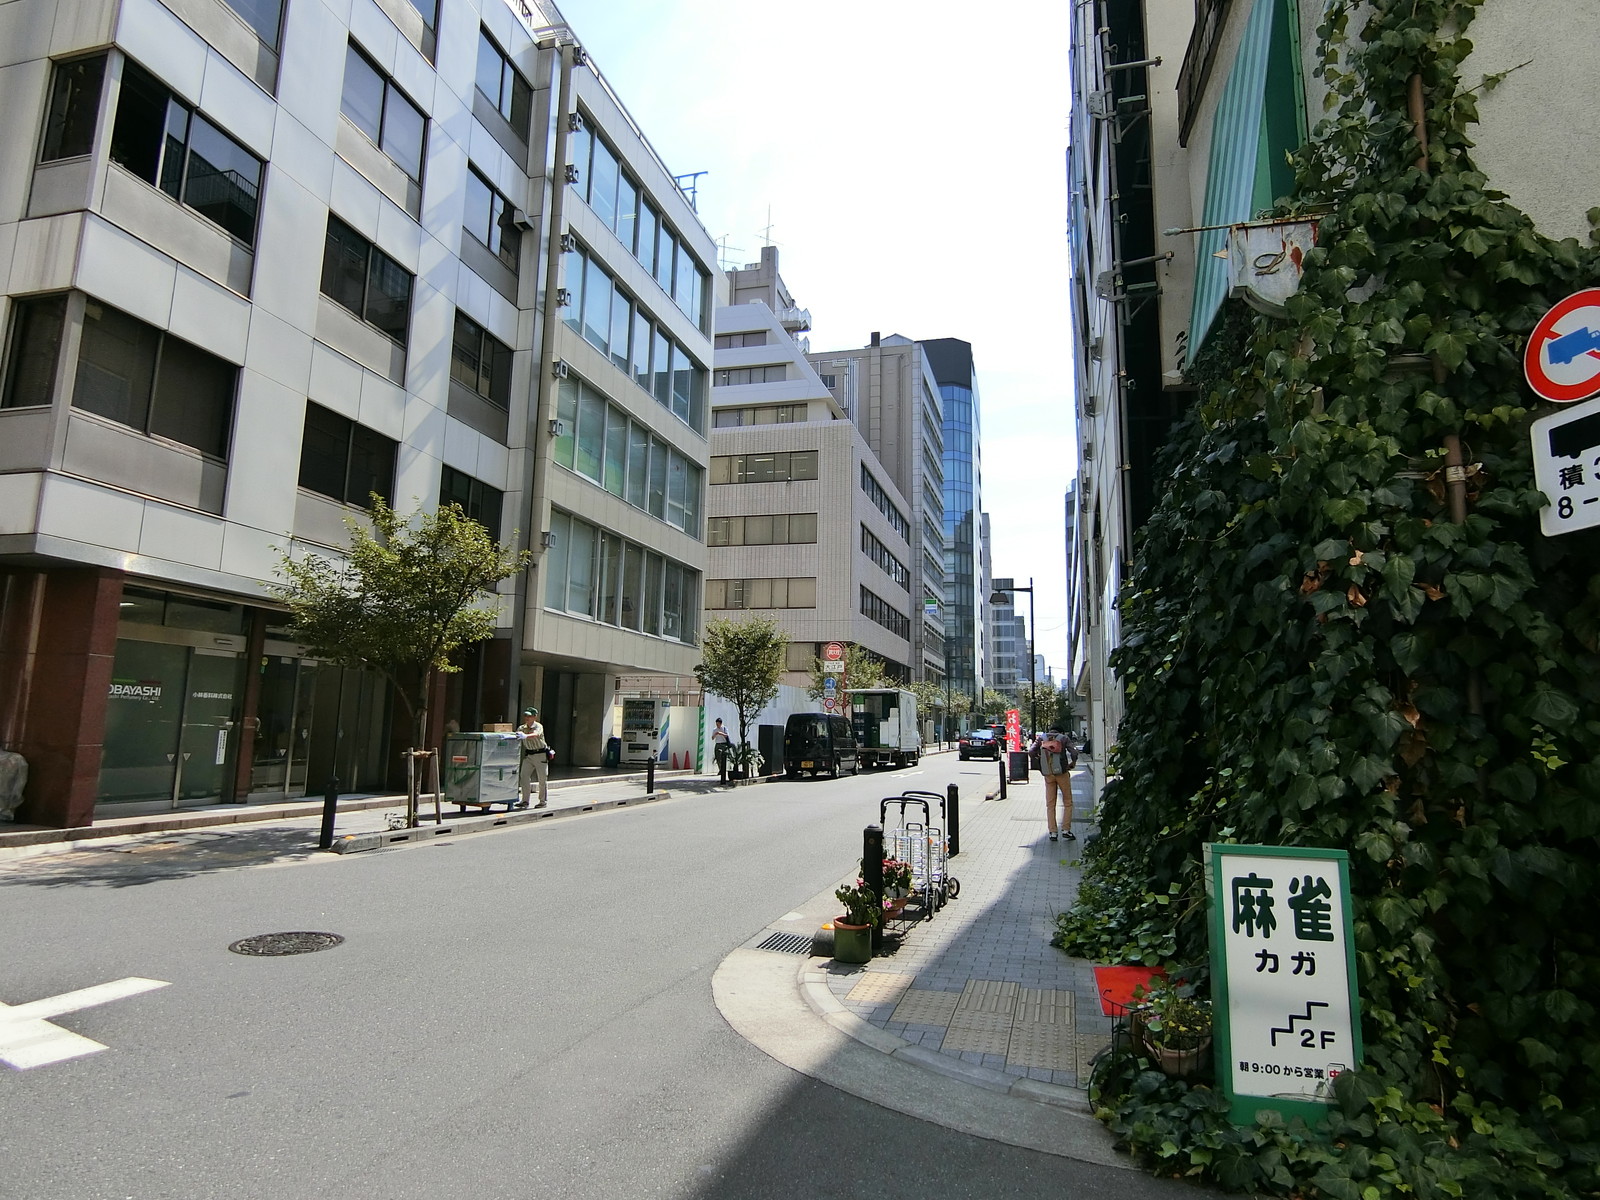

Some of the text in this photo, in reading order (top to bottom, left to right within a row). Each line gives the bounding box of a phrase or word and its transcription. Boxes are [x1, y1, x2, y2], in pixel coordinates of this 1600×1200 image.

[1231, 872, 1334, 942] 麻雀
[1254, 948, 1316, 976] カガ
[1300, 1028, 1336, 1050] 2F
